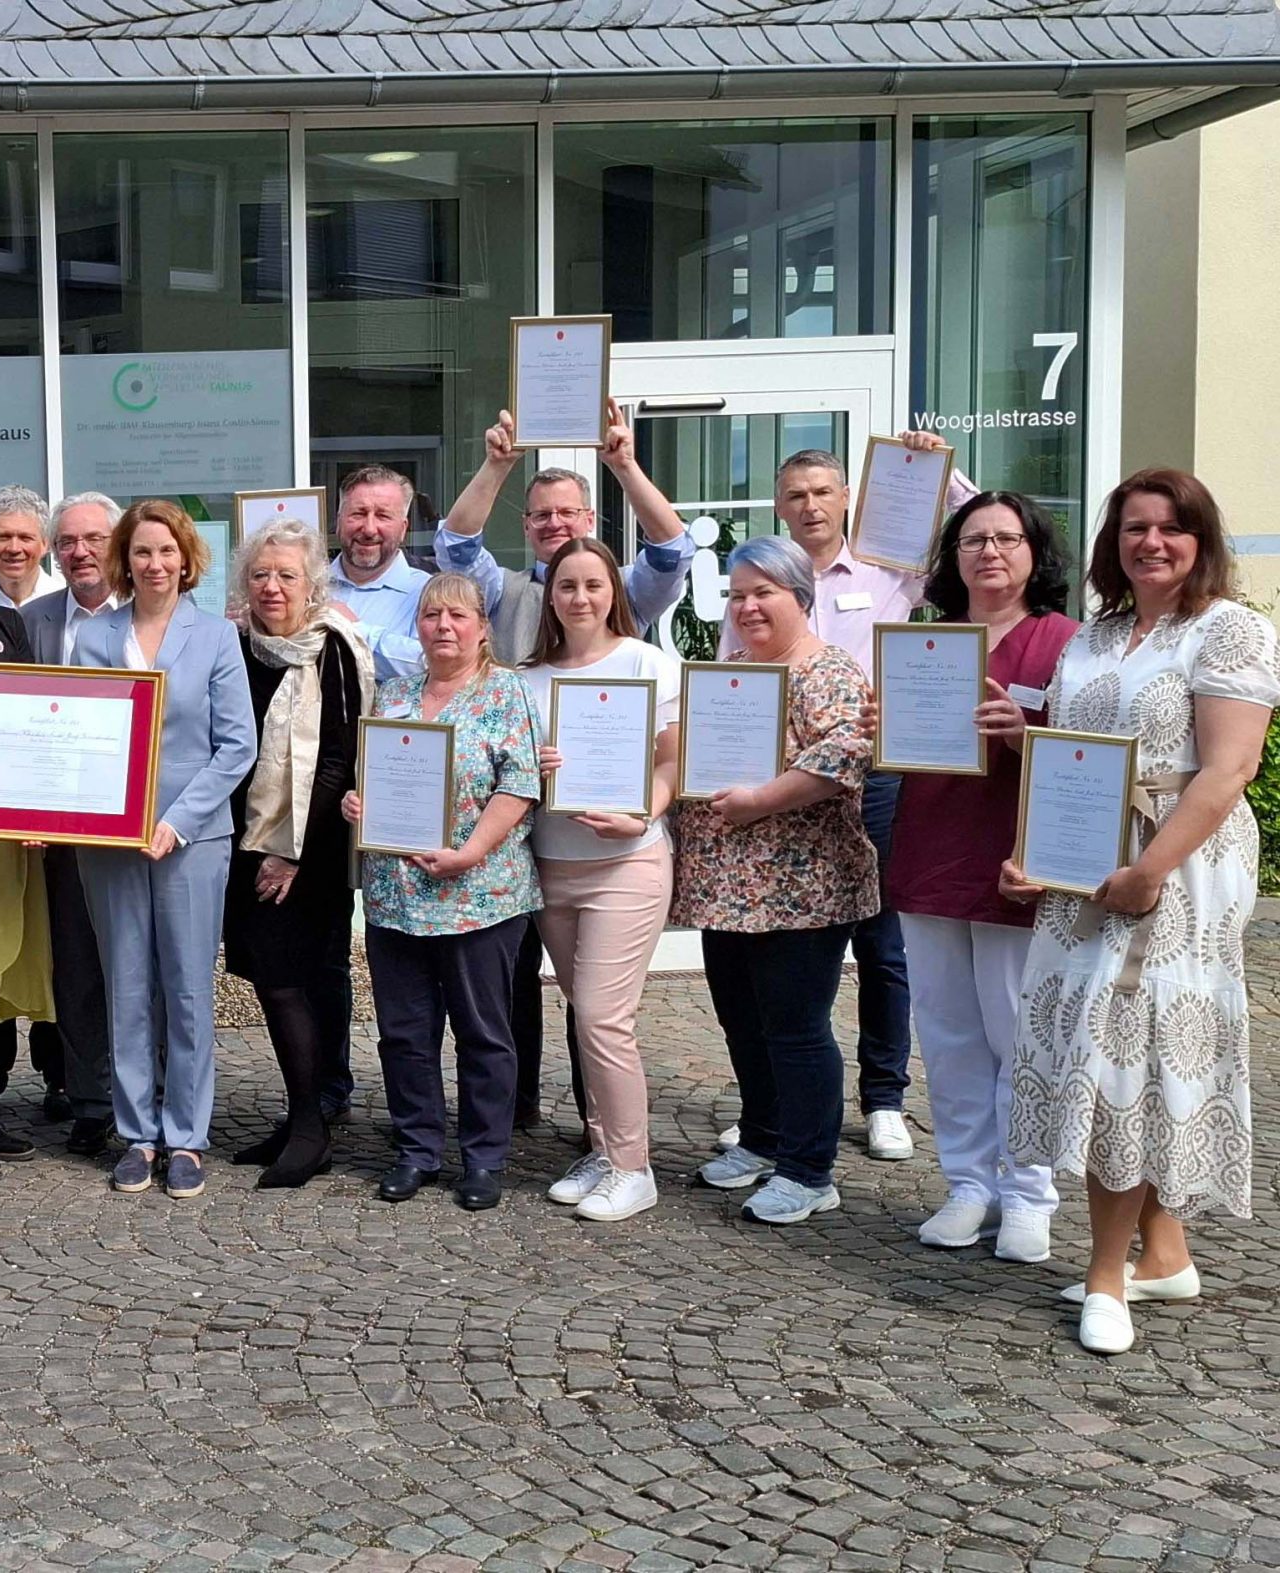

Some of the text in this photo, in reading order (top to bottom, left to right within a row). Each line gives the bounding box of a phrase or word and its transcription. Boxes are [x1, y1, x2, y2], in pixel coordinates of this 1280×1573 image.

[1033, 332, 1077, 400] 7
[210, 382, 253, 392] TAUNUS
[914, 410, 1077, 434] Woogtalstrasse
